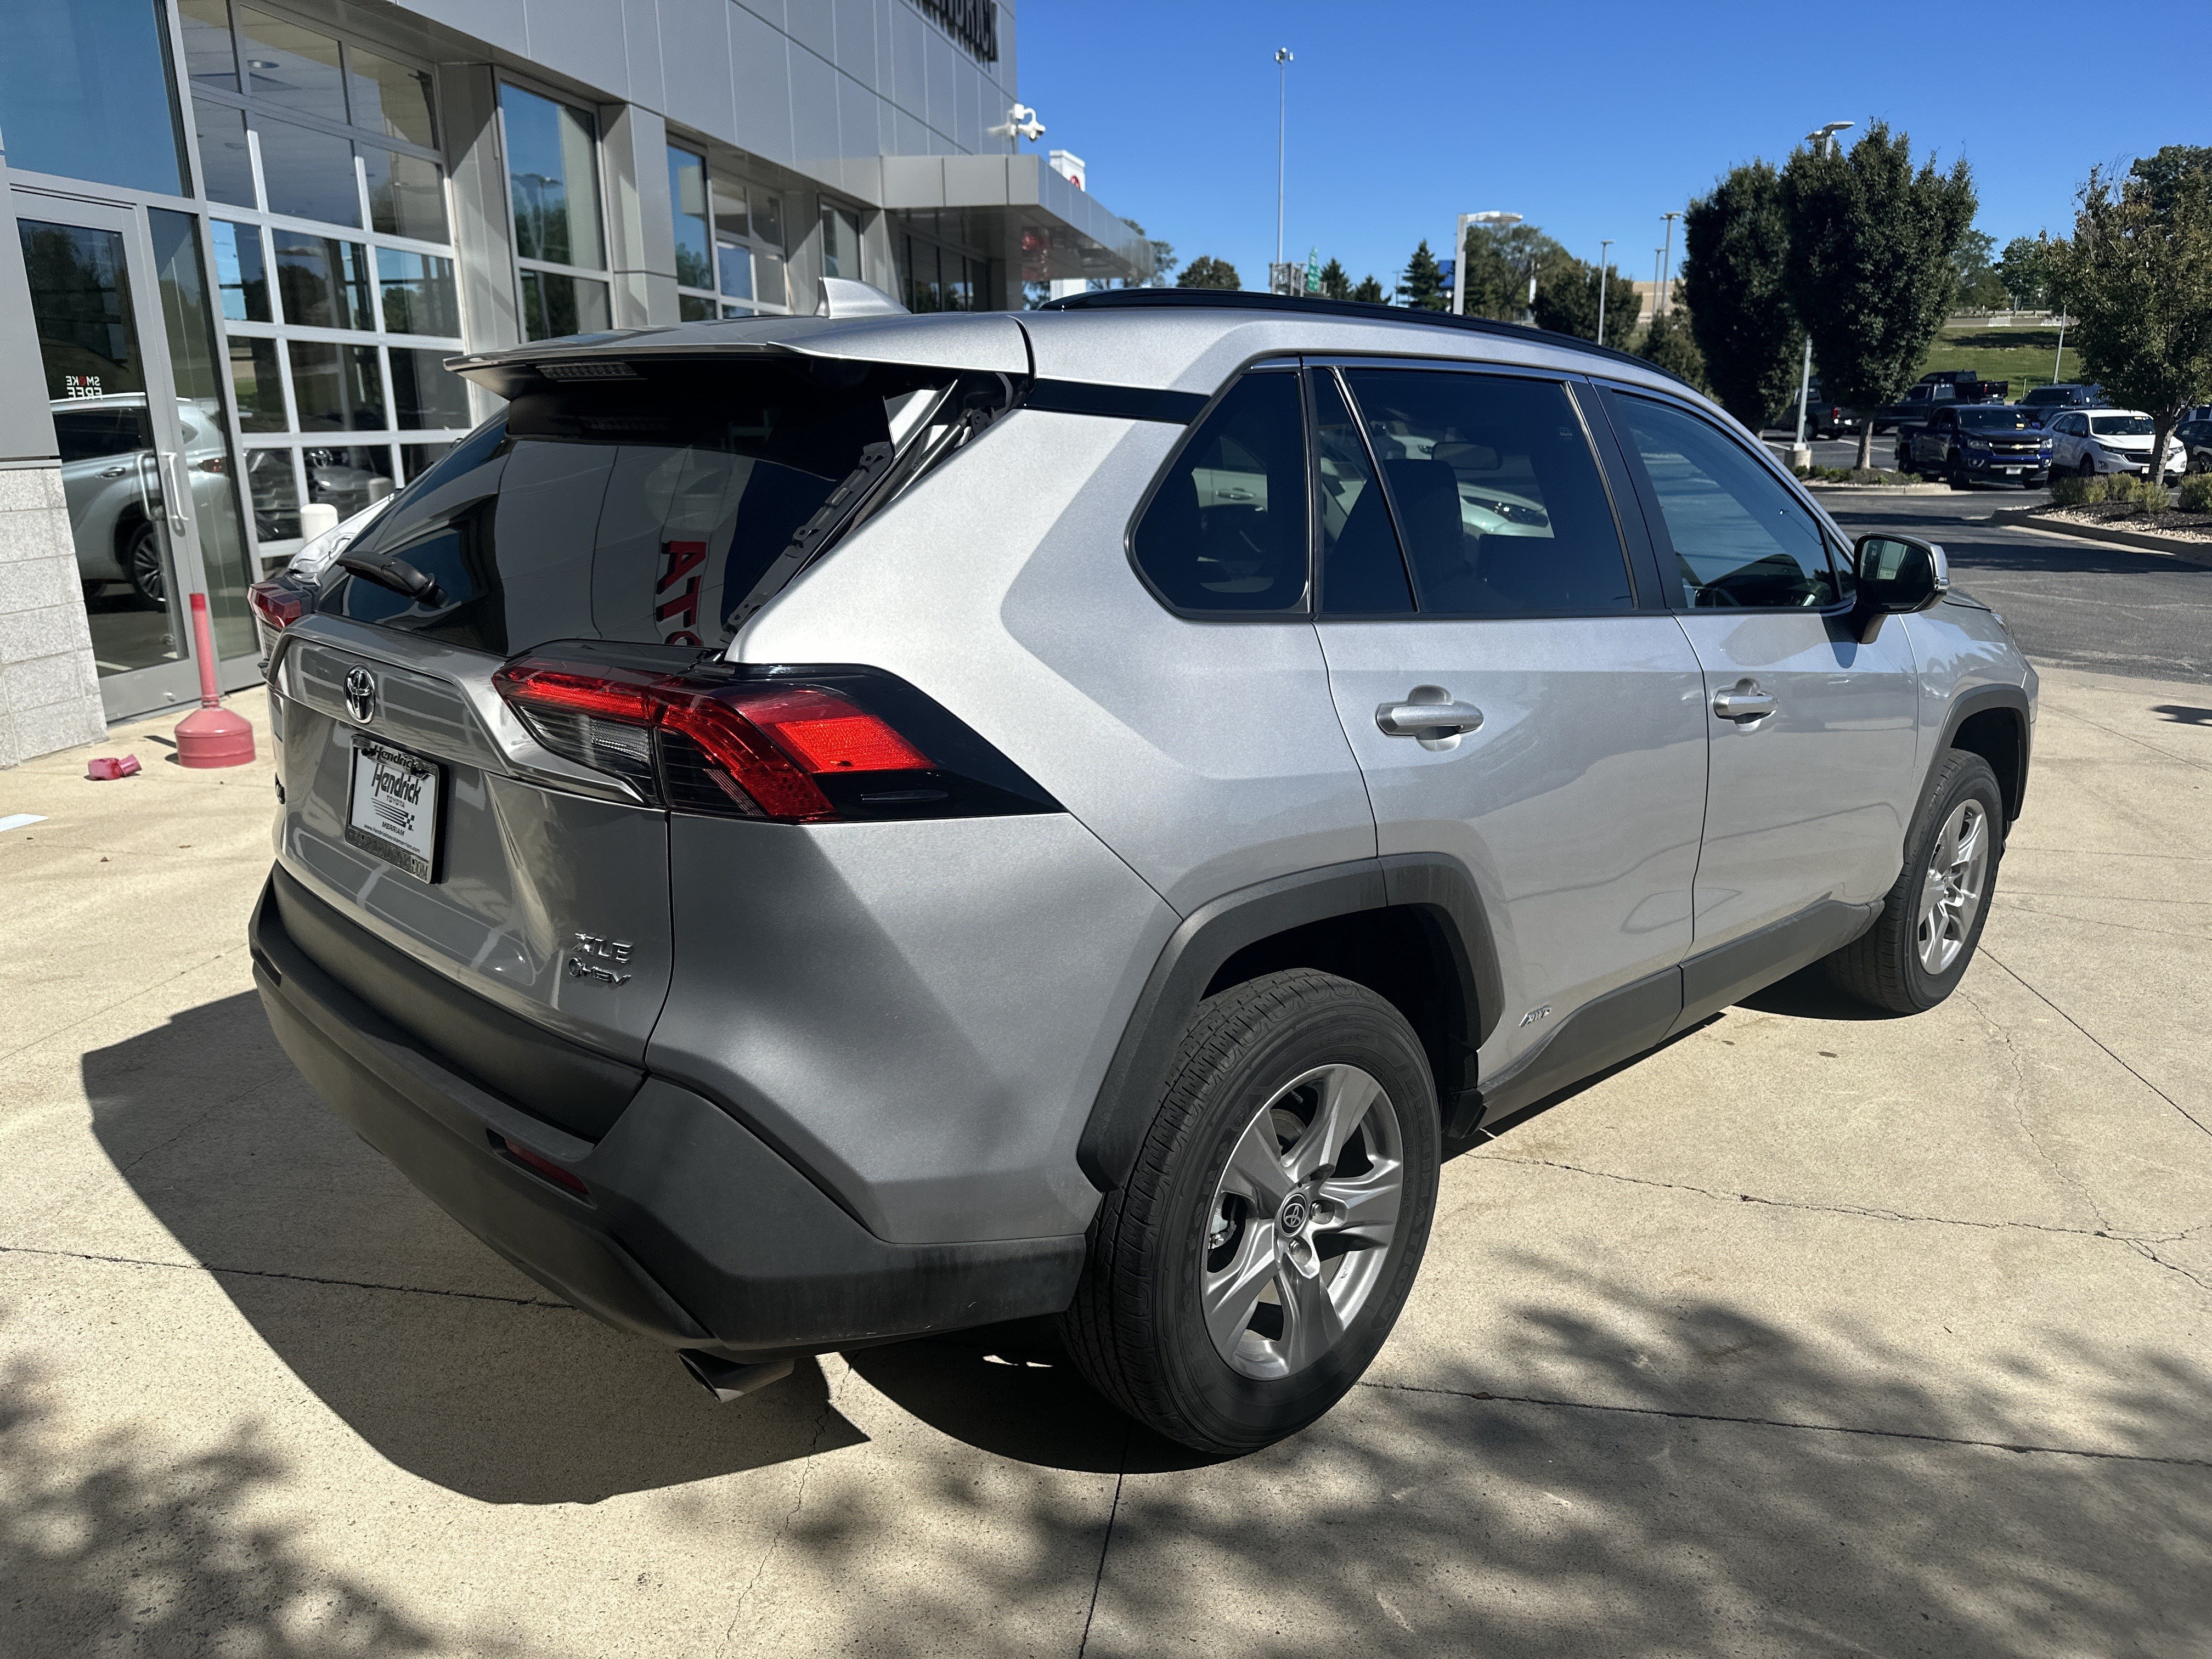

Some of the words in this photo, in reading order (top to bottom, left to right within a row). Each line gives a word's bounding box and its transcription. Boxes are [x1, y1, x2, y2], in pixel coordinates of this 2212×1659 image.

[371, 765, 422, 805] Hendrick
[386, 795, 405, 808] TOYOTA
[382, 821, 405, 837] MERRIAM
[572, 933, 633, 963] XLE
